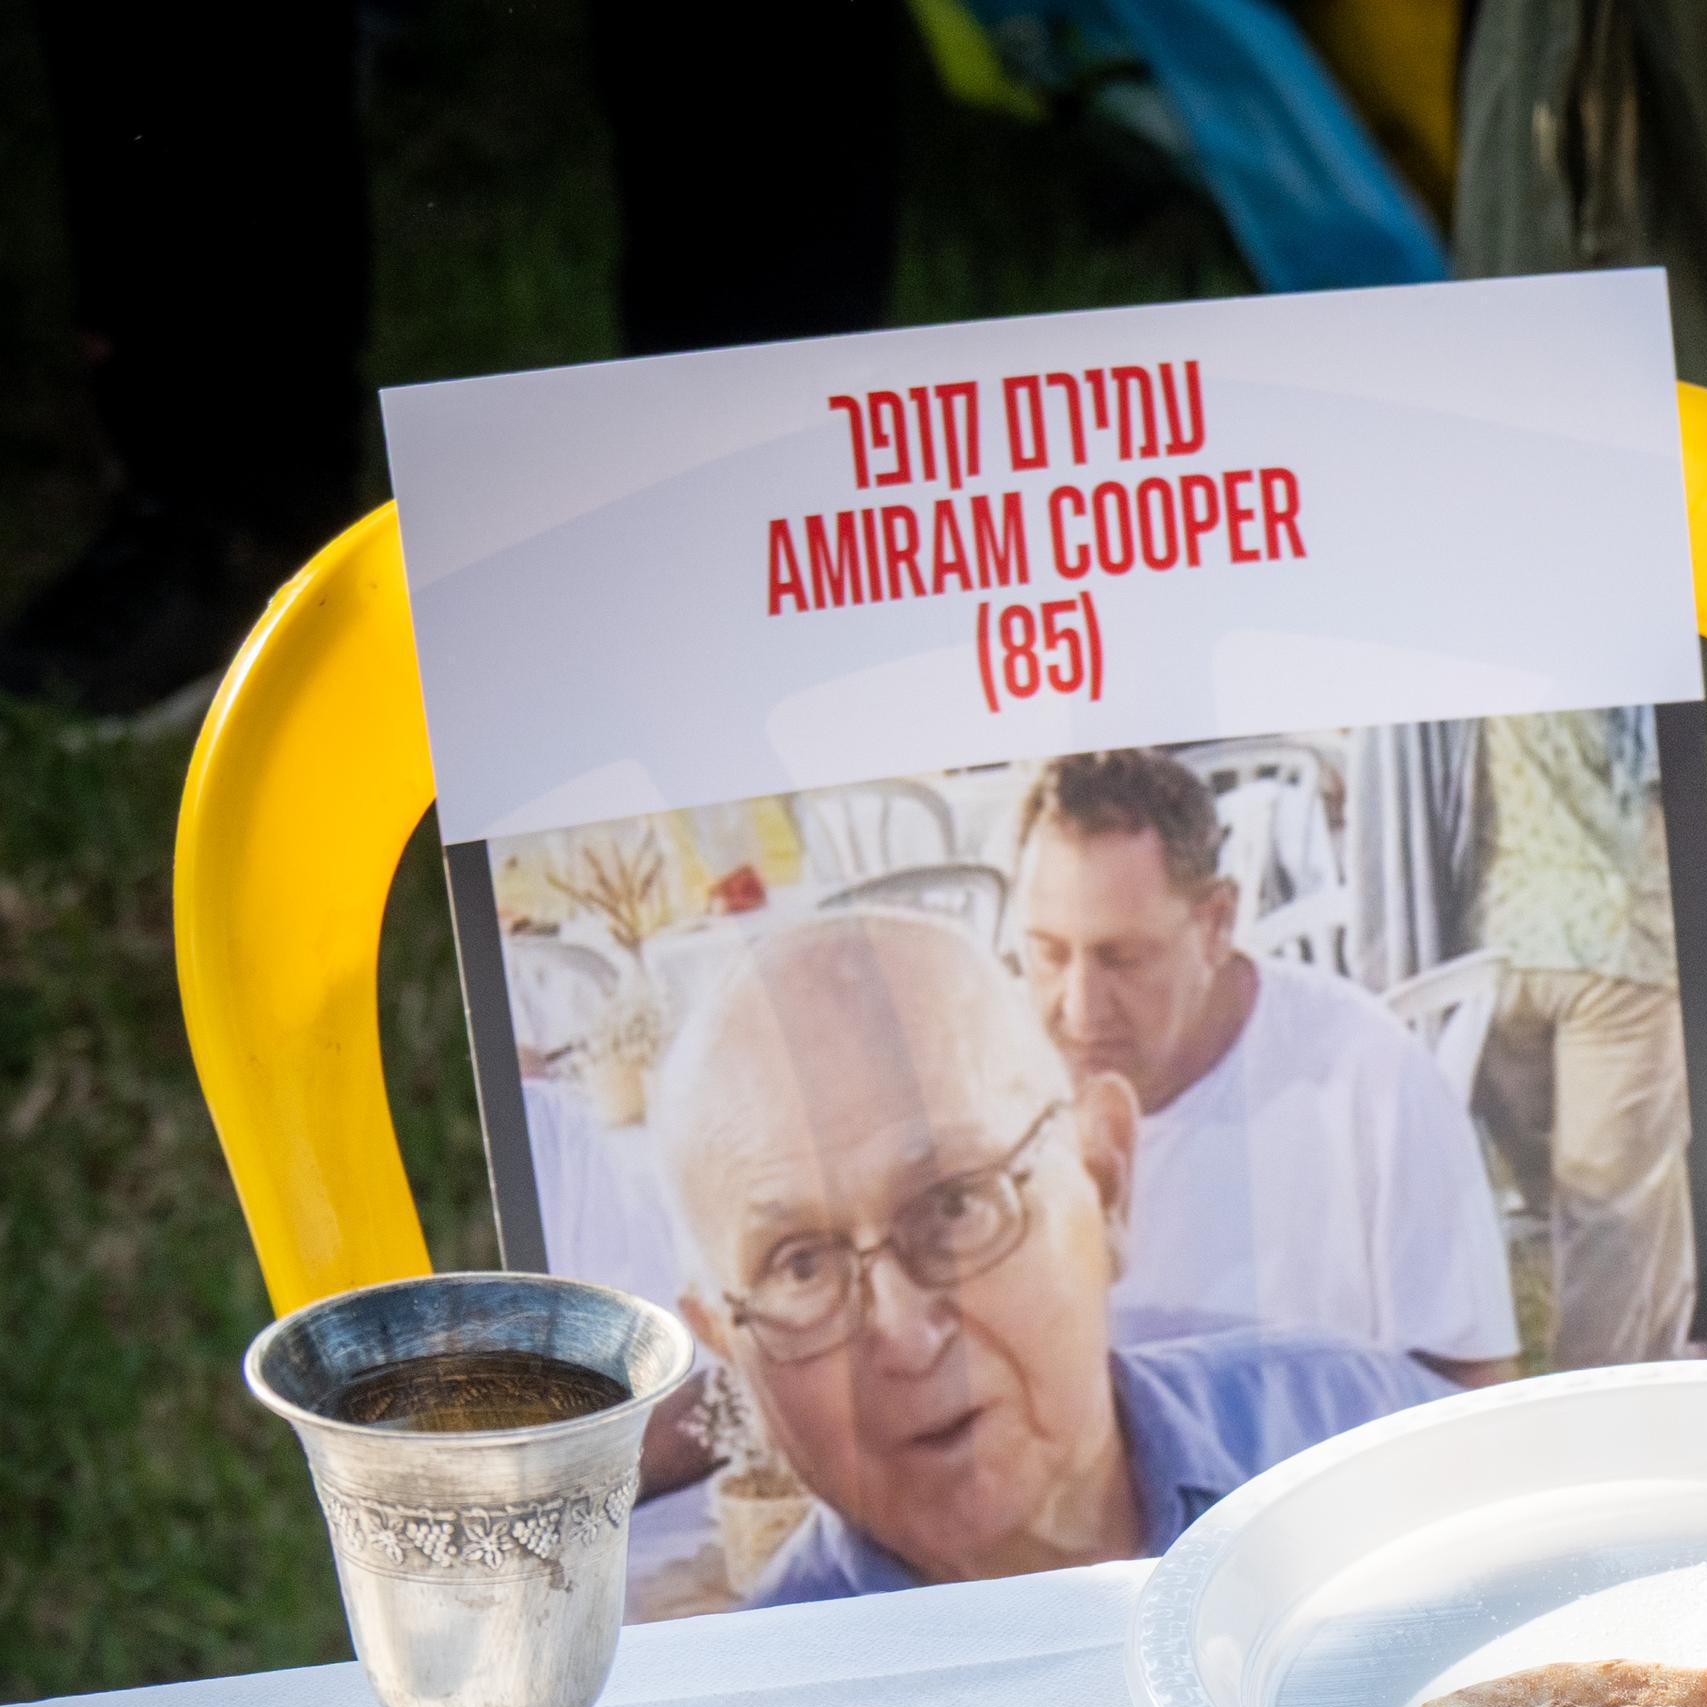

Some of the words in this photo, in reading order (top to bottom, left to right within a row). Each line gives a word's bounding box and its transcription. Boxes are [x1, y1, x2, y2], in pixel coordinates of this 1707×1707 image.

[828, 381, 980, 491] קופר
[1002, 360, 1205, 472] עמירם
[767, 491, 1032, 617] AMIRAM
[1048, 467, 1306, 580] COOPER
[977, 591, 1103, 713] (85)
